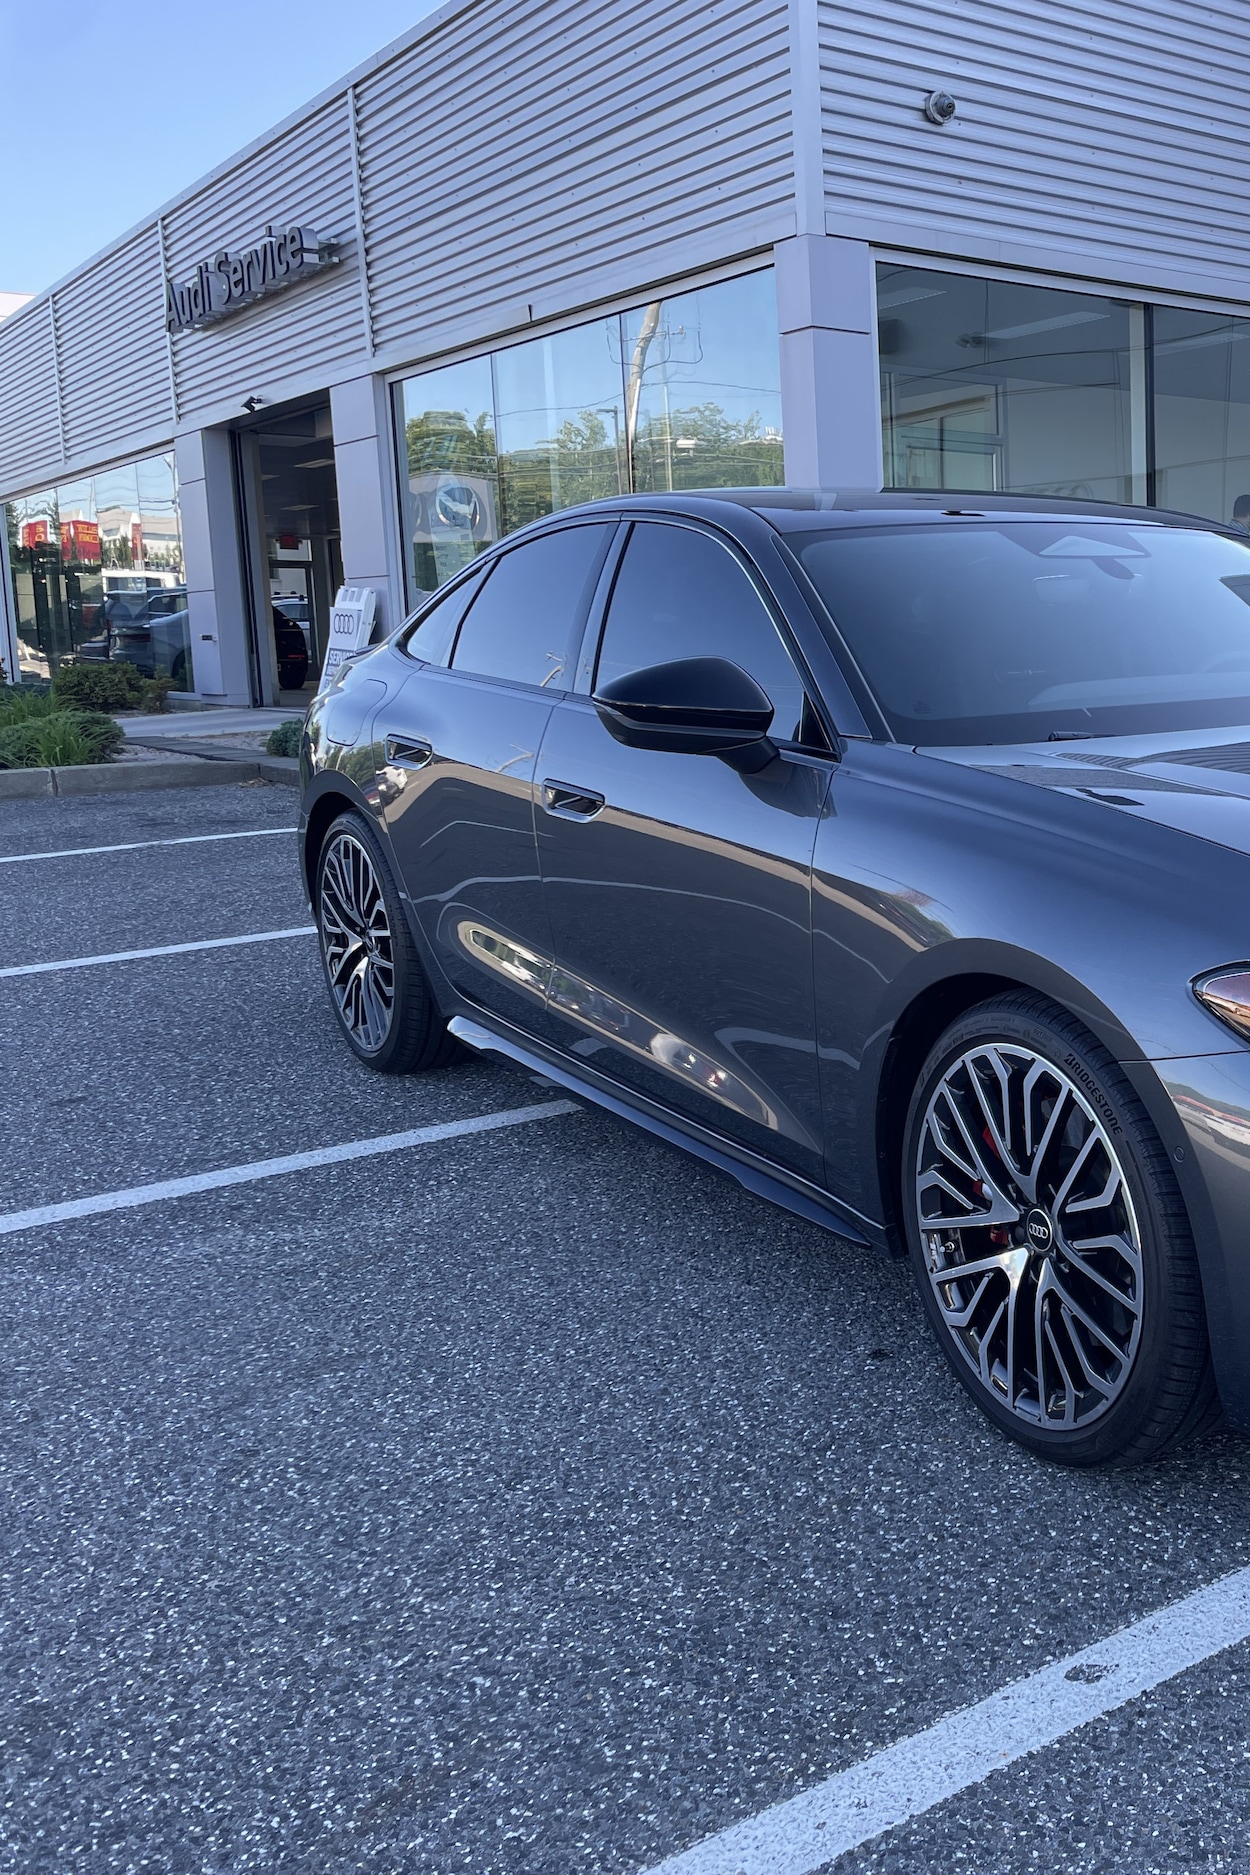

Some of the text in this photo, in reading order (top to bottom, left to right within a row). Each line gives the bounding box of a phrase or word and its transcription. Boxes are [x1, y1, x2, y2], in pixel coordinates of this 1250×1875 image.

[165, 225, 312, 333] Audi Service
[1063, 1053, 1123, 1135] BRIDGESTONE
